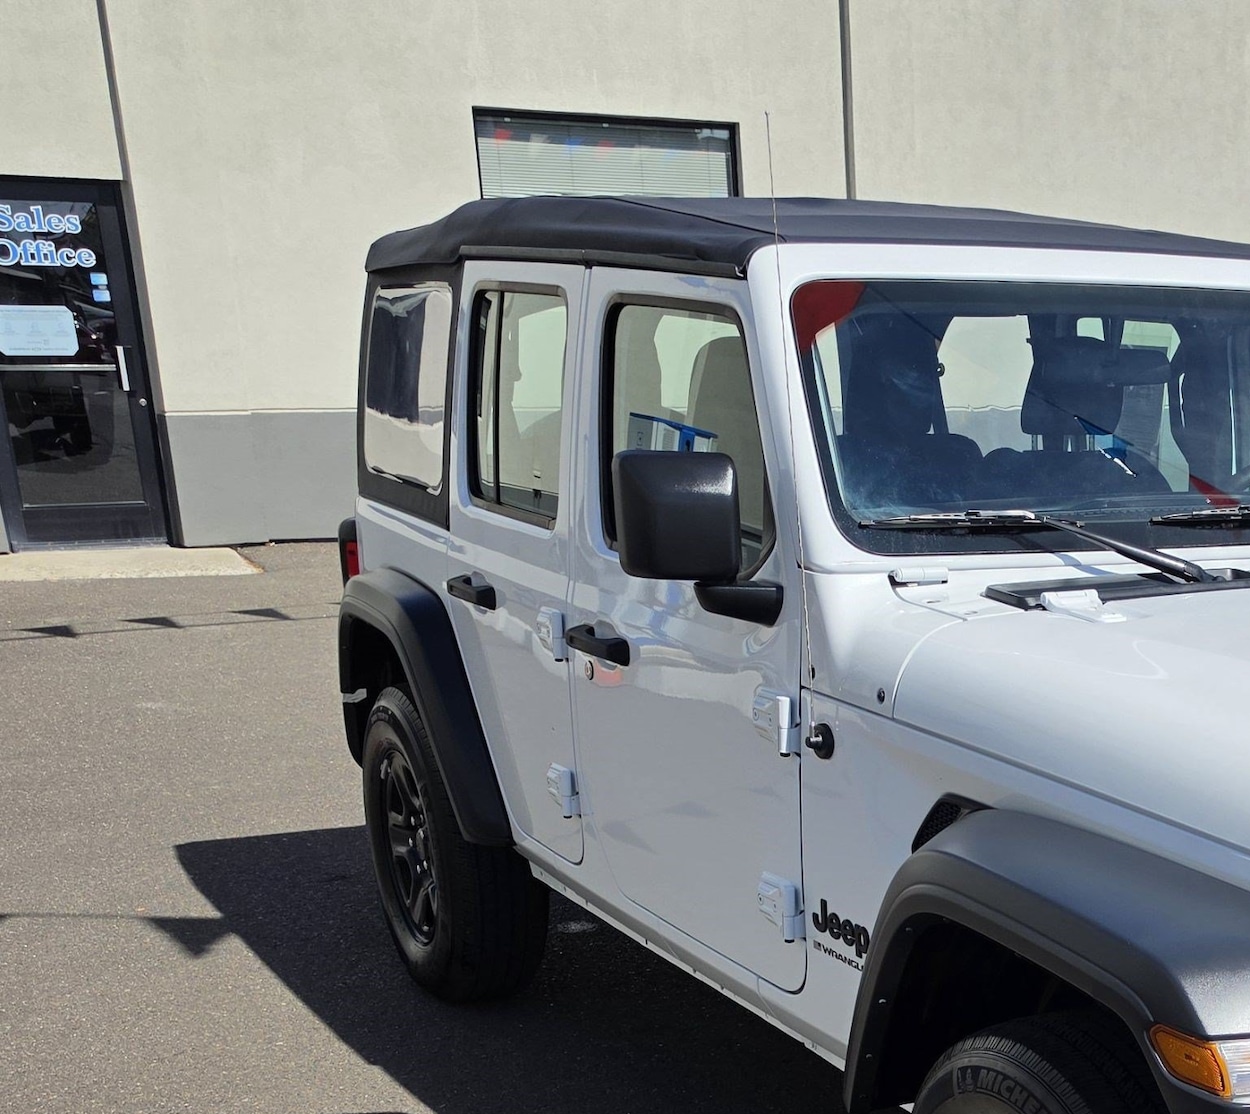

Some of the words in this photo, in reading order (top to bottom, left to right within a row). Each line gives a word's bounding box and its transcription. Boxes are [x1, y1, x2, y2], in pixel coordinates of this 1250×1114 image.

[0, 203, 82, 234] Sales
[0, 237, 97, 268] Office
[812, 898, 870, 958] Jeep
[821, 942, 864, 972] WRANGL
